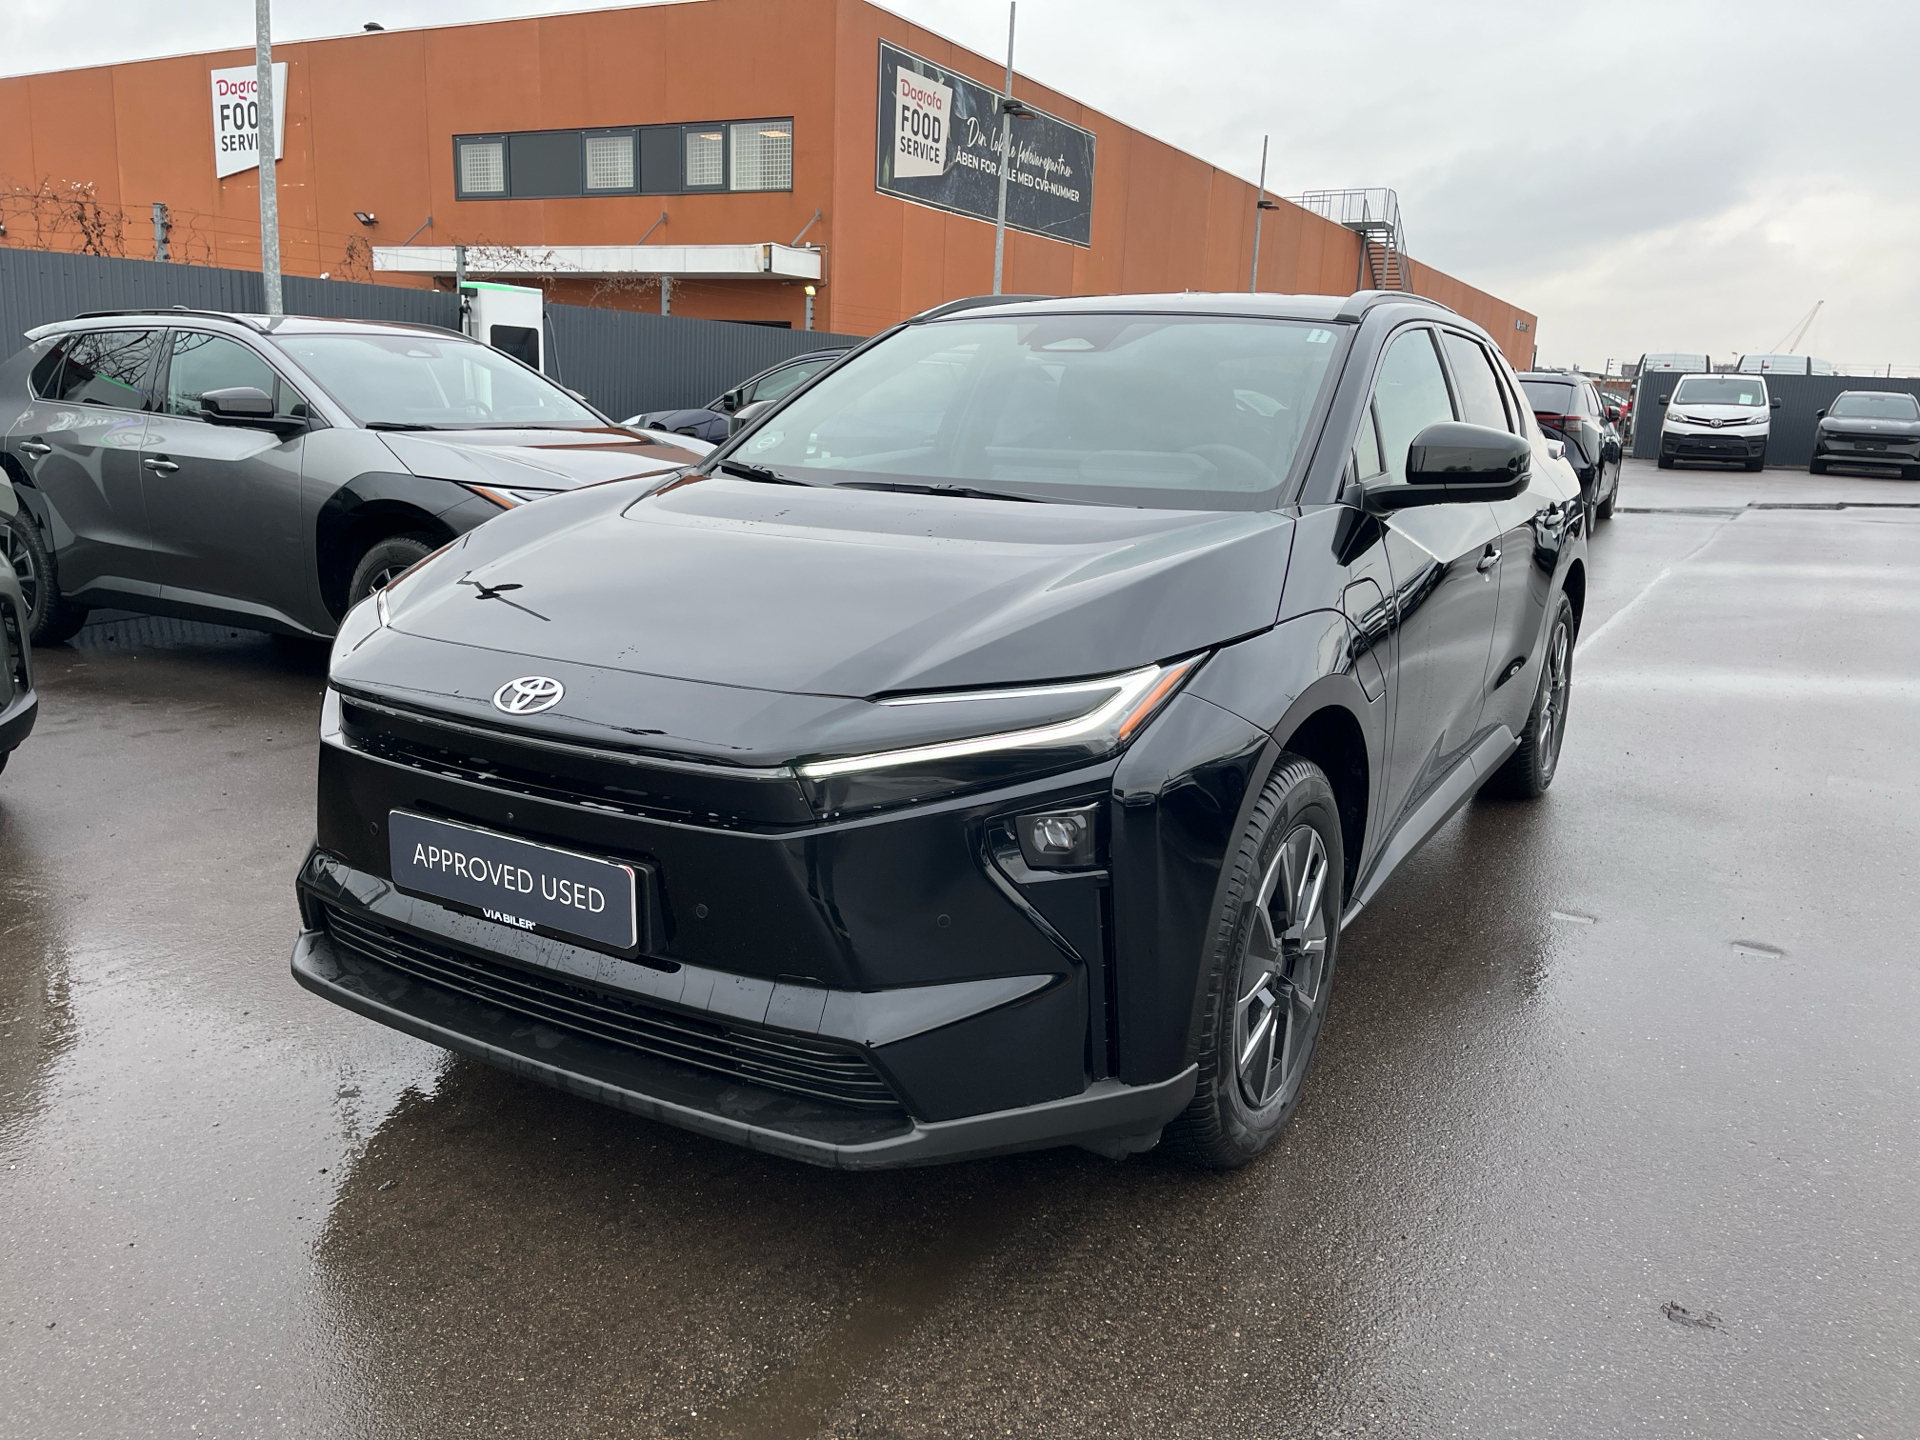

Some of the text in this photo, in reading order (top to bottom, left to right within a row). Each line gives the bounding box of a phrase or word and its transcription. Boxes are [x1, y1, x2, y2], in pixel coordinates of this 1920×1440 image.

[216, 79, 258, 101] Dagro
[900, 78, 942, 111] Dagrofa
[220, 101, 259, 132] FOO
[901, 104, 941, 144] FOOD
[221, 133, 259, 152] SERVI
[900, 135, 940, 165] SERVICE
[967, 117, 987, 148] Din
[990, 126, 1016, 158] lokle
[955, 145, 1080, 203] ÅBEN FOR ALE MED CVR-NUMMER
[412, 842, 606, 914] APPROVED USED
